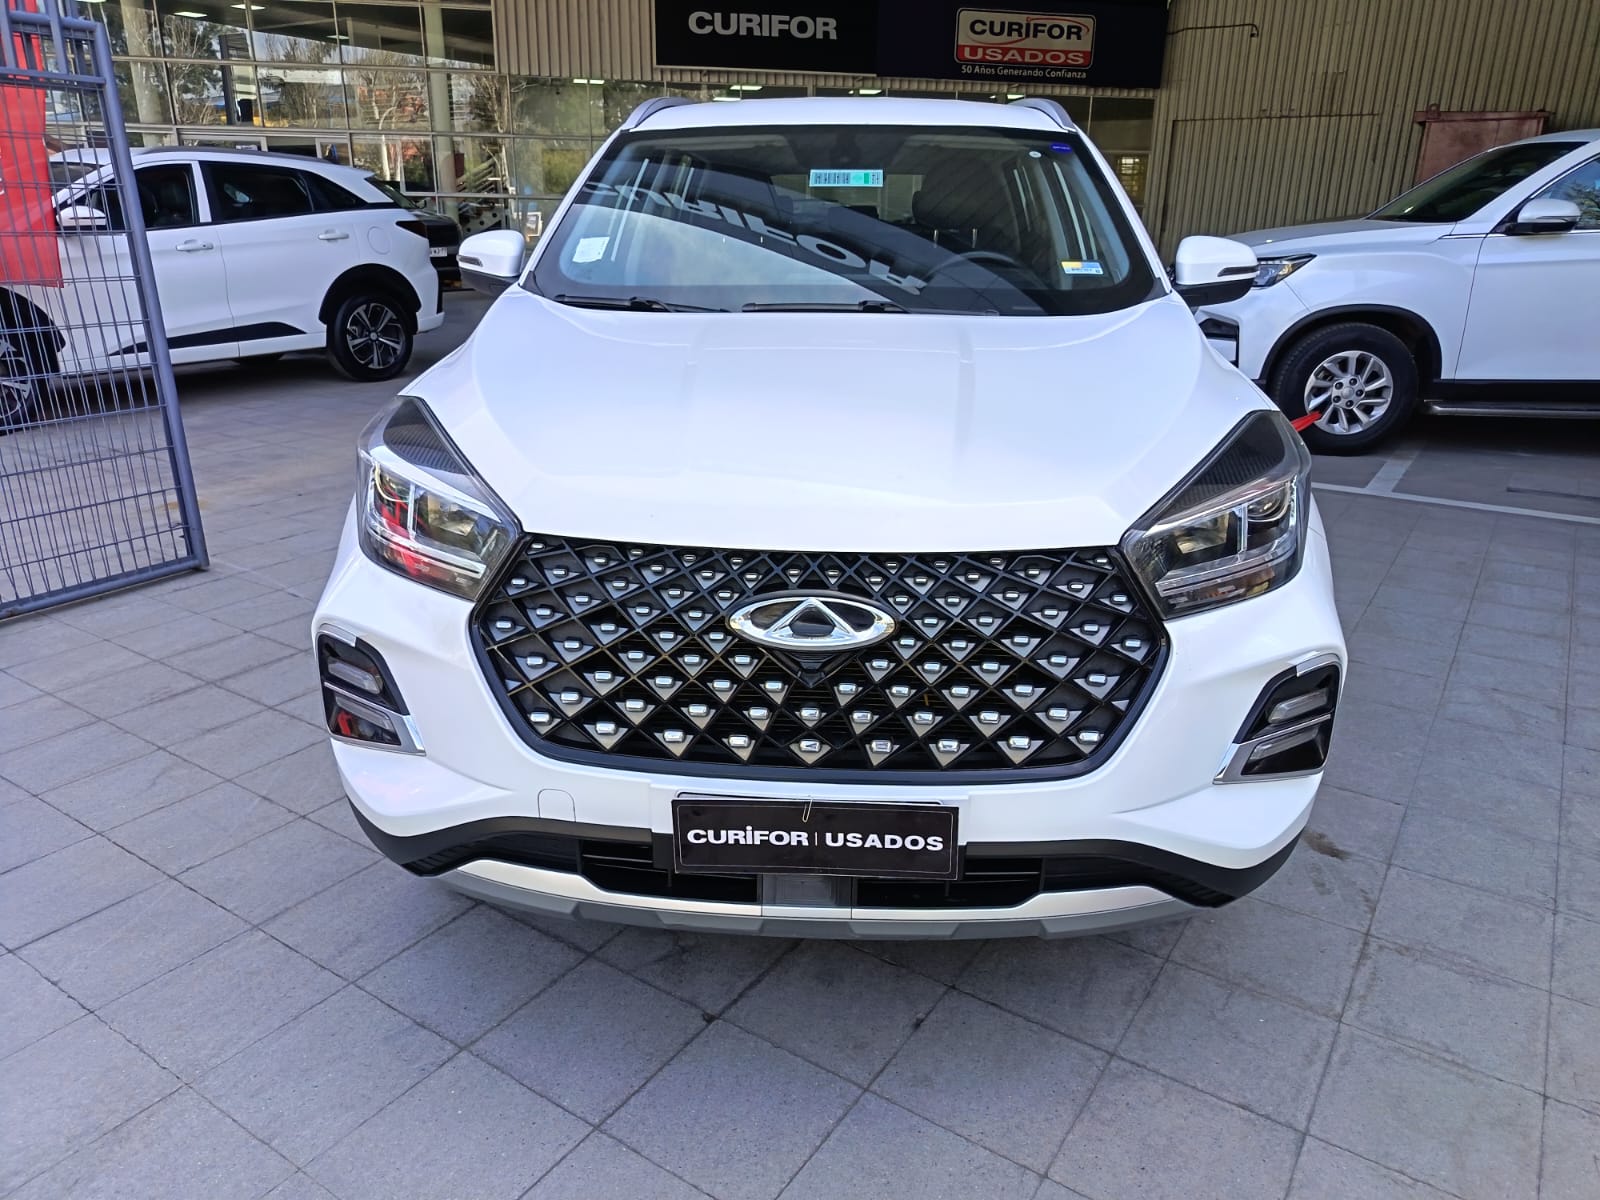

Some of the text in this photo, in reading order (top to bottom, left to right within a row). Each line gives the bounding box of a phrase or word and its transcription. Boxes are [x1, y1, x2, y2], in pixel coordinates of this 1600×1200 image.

[688, 11, 837, 40] CURIFOR
[963, 46, 1085, 65] USADOS
[961, 65, 1087, 79] 50 Años Generando Confianza
[825, 832, 944, 852] USADOS
